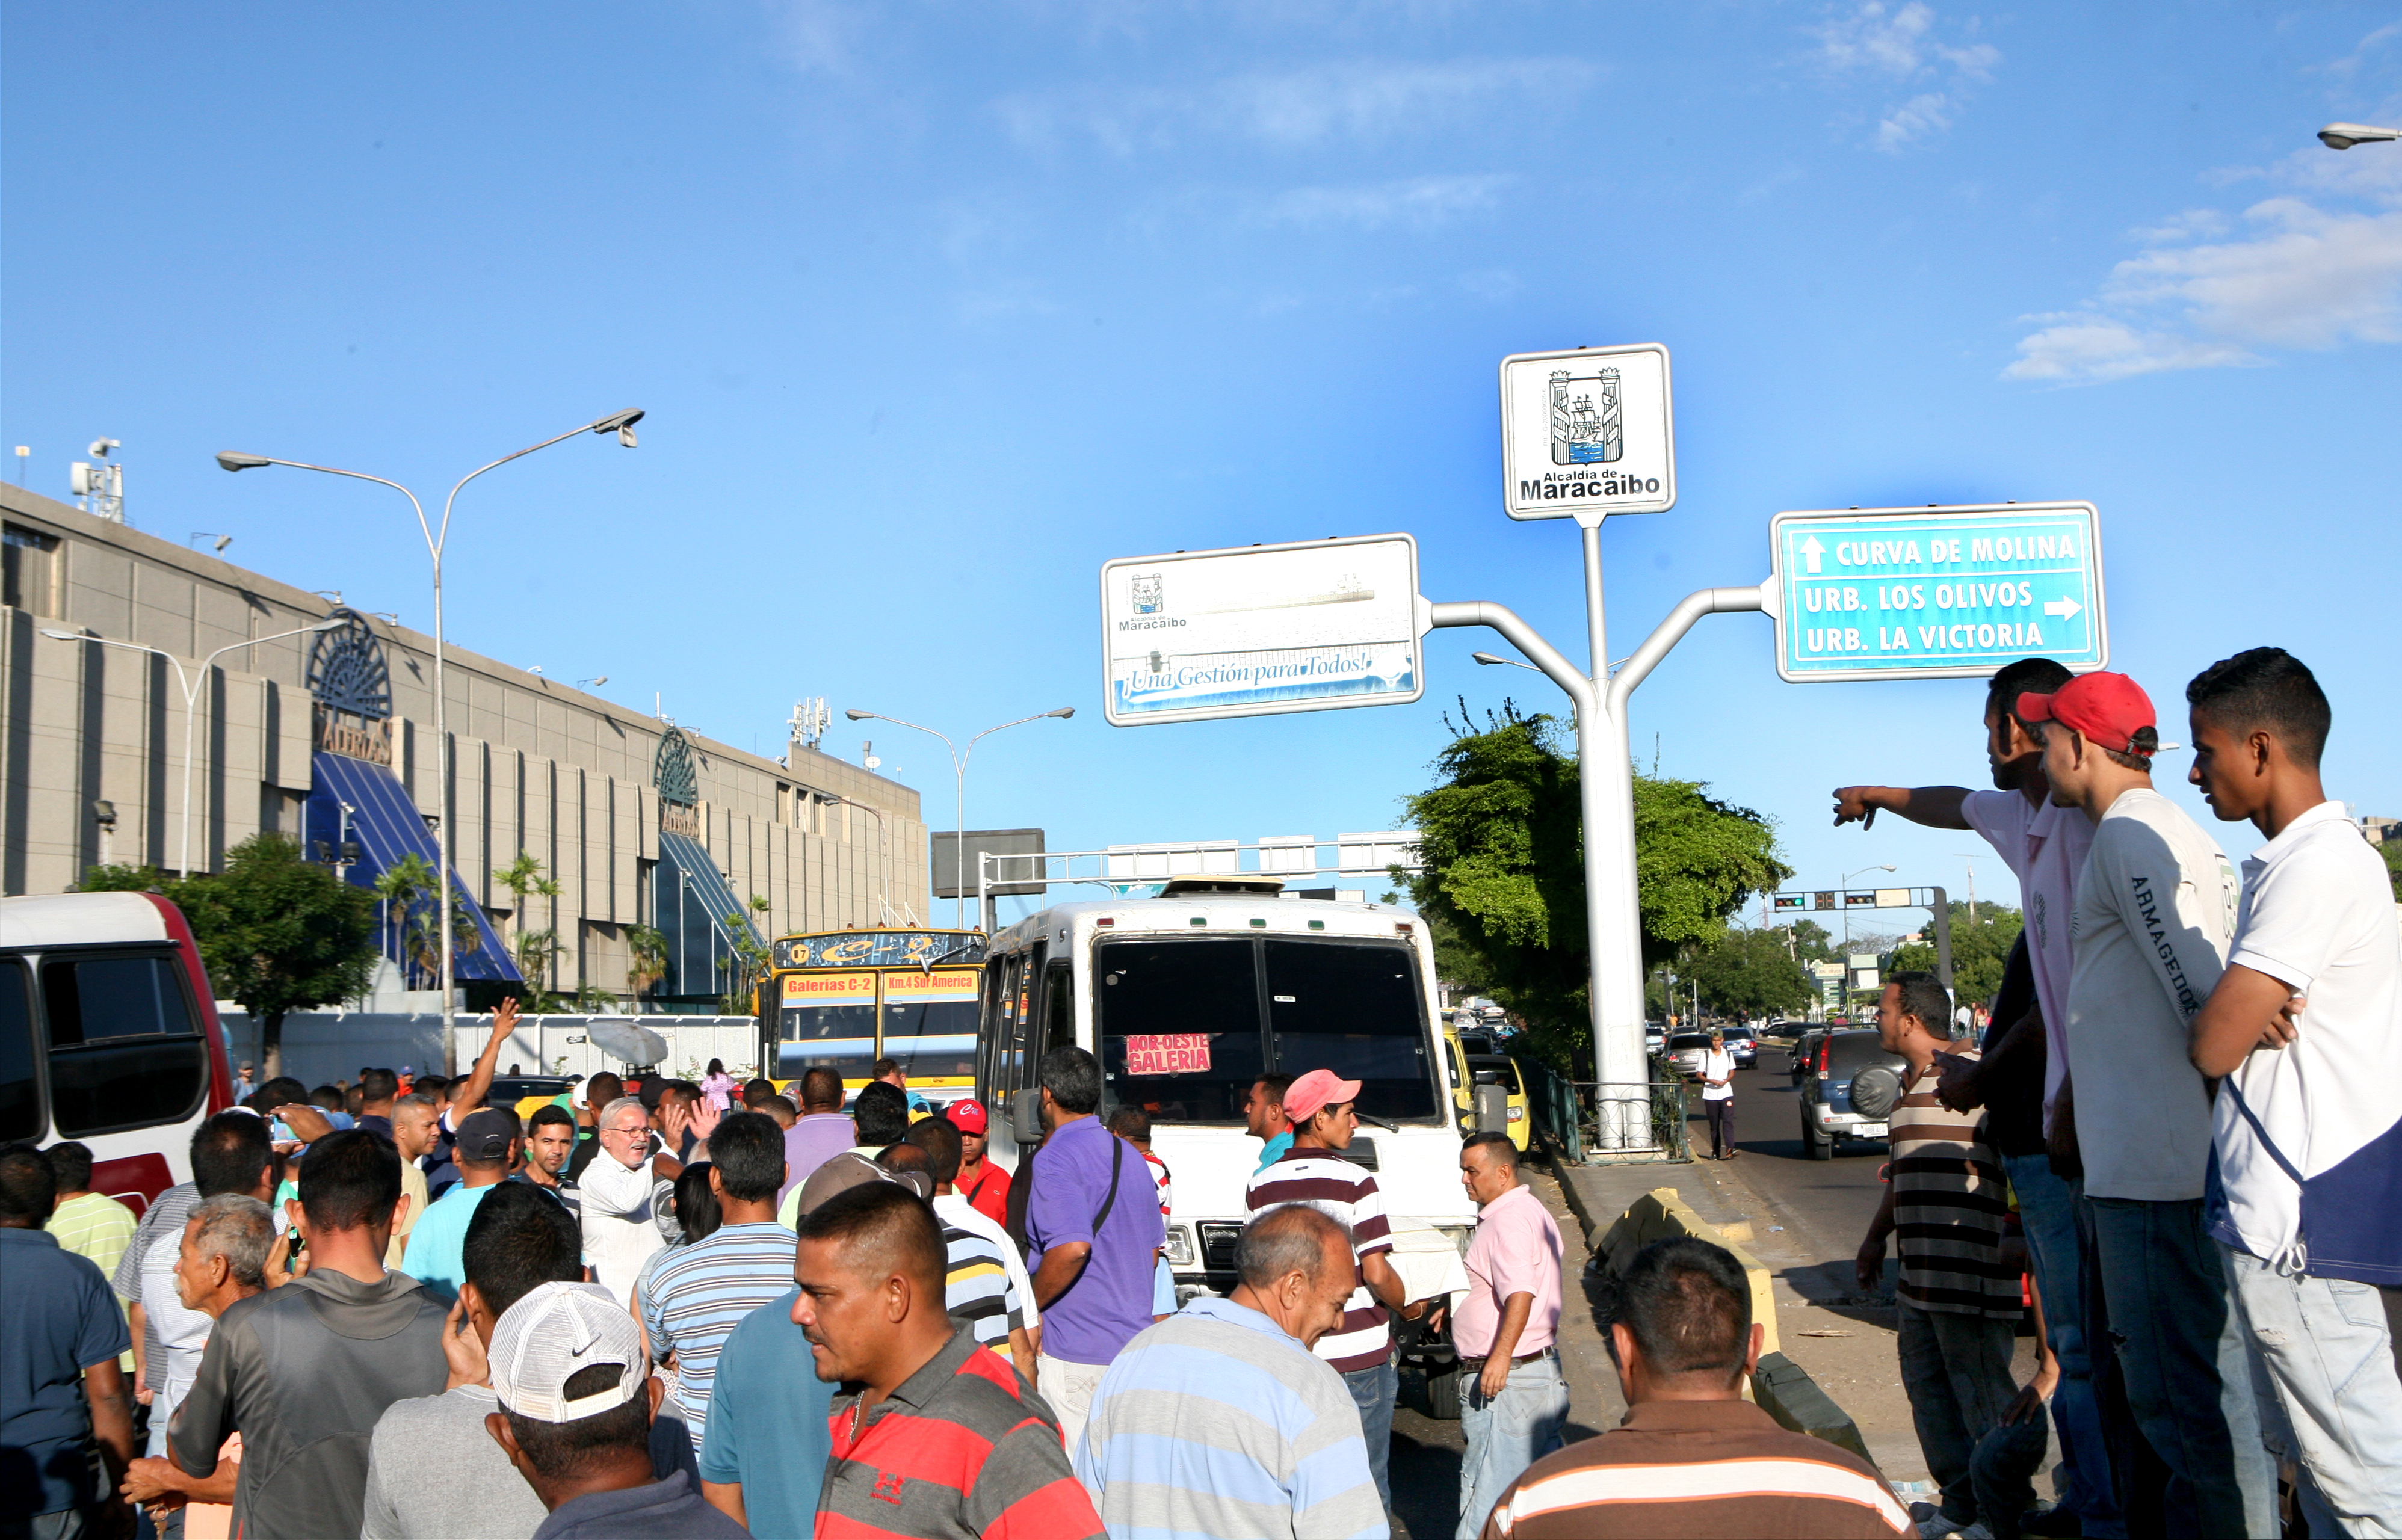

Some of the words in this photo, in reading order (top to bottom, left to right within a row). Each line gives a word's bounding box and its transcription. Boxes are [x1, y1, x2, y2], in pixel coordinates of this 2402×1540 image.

[1521, 474, 1660, 500] Maracaibo
[1543, 470, 1597, 482] Alcaldía
[1602, 469, 1617, 478] de
[1836, 540, 1921, 567] CURVA
[1930, 538, 1962, 564] DE
[1971, 535, 2075, 563] MOLINA
[1805, 586, 1868, 612] URB.
[1878, 584, 1925, 611] LOS
[1935, 581, 2033, 609] OLIVOS
[1119, 617, 1187, 632] Maracaibo
[1807, 627, 1869, 652] URB.
[1879, 626, 1910, 650] LA
[1918, 622, 2044, 649] VICTORIA
[1124, 670, 1172, 697] ¡Una
[1177, 662, 1248, 686] Gestión
[1252, 666, 1300, 686] para
[1304, 652, 1366, 677] Todos!
[789, 979, 845, 993] Galerías
[848, 978, 871, 990] C-2
[889, 976, 912, 988] Km.4
[914, 976, 930, 988] Sur
[931, 975, 972, 987] America
[1129, 1034, 1208, 1052] NOR-OESTE
[1129, 1049, 1209, 1072] GALERIA
